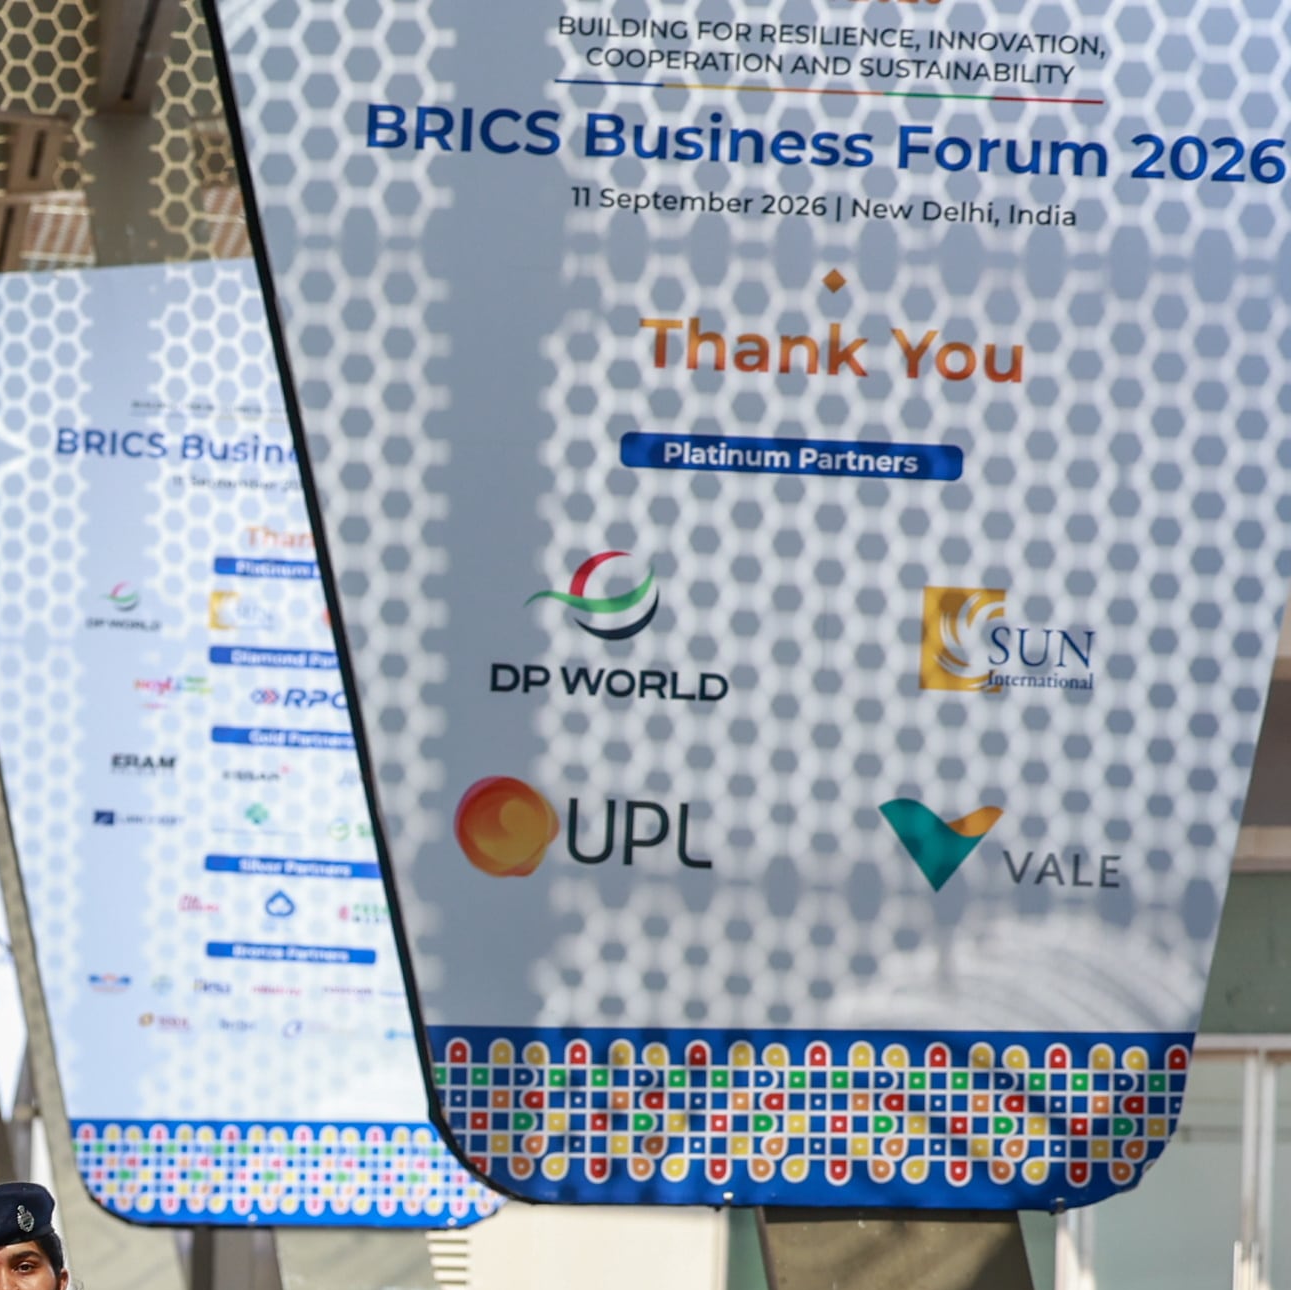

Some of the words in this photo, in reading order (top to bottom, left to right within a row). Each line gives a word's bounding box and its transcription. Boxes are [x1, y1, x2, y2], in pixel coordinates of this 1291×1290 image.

[558, 16, 688, 41] BUILDING
[697, 21, 751, 44] FOR
[759, 23, 921, 53] RESILIENCE,
[928, 29, 1106, 60] INNOVATION,
[586, 46, 785, 77] COOPERATION
[791, 54, 851, 78] AND
[859, 57, 1075, 87] SUSTAINABILITY
[366, 103, 562, 158] BRICS
[585, 111, 874, 170] Business
[896, 123, 1109, 179] Forum
[1130, 132, 1288, 186] 2026
[570, 185, 591, 208] 11
[597, 186, 756, 222] September
[760, 193, 828, 220] 2026
[849, 197, 915, 222] New
[921, 197, 1001, 230] Delhi,
[1007, 202, 1079, 229] India
[638, 316, 869, 380] Thank
[890, 328, 1025, 385] You
[56, 427, 169, 460] BRICS
[663, 442, 791, 473] Platinum
[798, 445, 920, 477] Partners
[246, 525, 316, 550] Than
[987, 626, 1097, 670] SUN
[489, 663, 551, 697] DP
[557, 668, 730, 704] WORLD
[987, 668, 1096, 692] International
[566, 798, 714, 871] UPL
[1002, 849, 1123, 890] VALE
